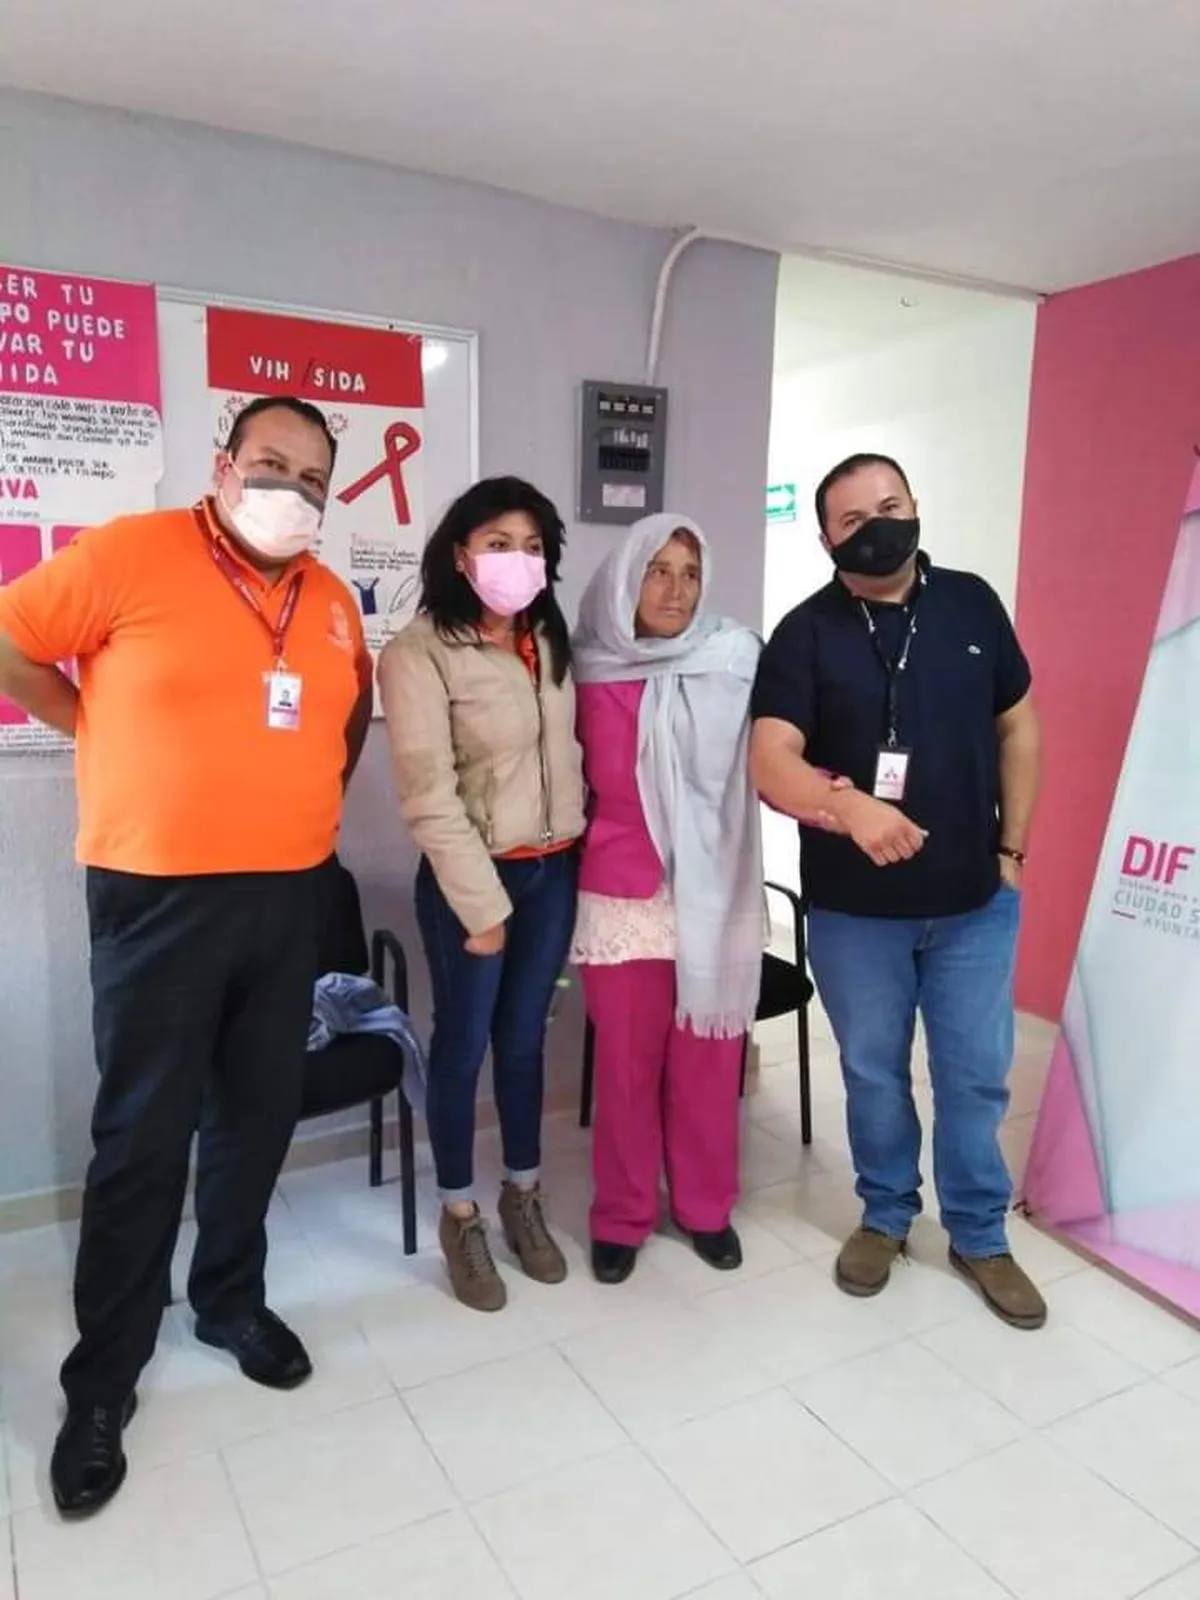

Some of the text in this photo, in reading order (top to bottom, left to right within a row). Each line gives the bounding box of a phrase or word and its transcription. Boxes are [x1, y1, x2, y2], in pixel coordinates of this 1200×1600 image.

[0, 273, 94, 306] ER TU
[47, 308, 125, 340] PUEDE
[62, 339, 94, 363] TU
[0, 362, 58, 386] IDA
[249, 355, 290, 382] VIH
[0, 478, 39, 500] VA
[1121, 835, 1197, 885] DIF
[1114, 888, 1182, 920] CIUDAD
